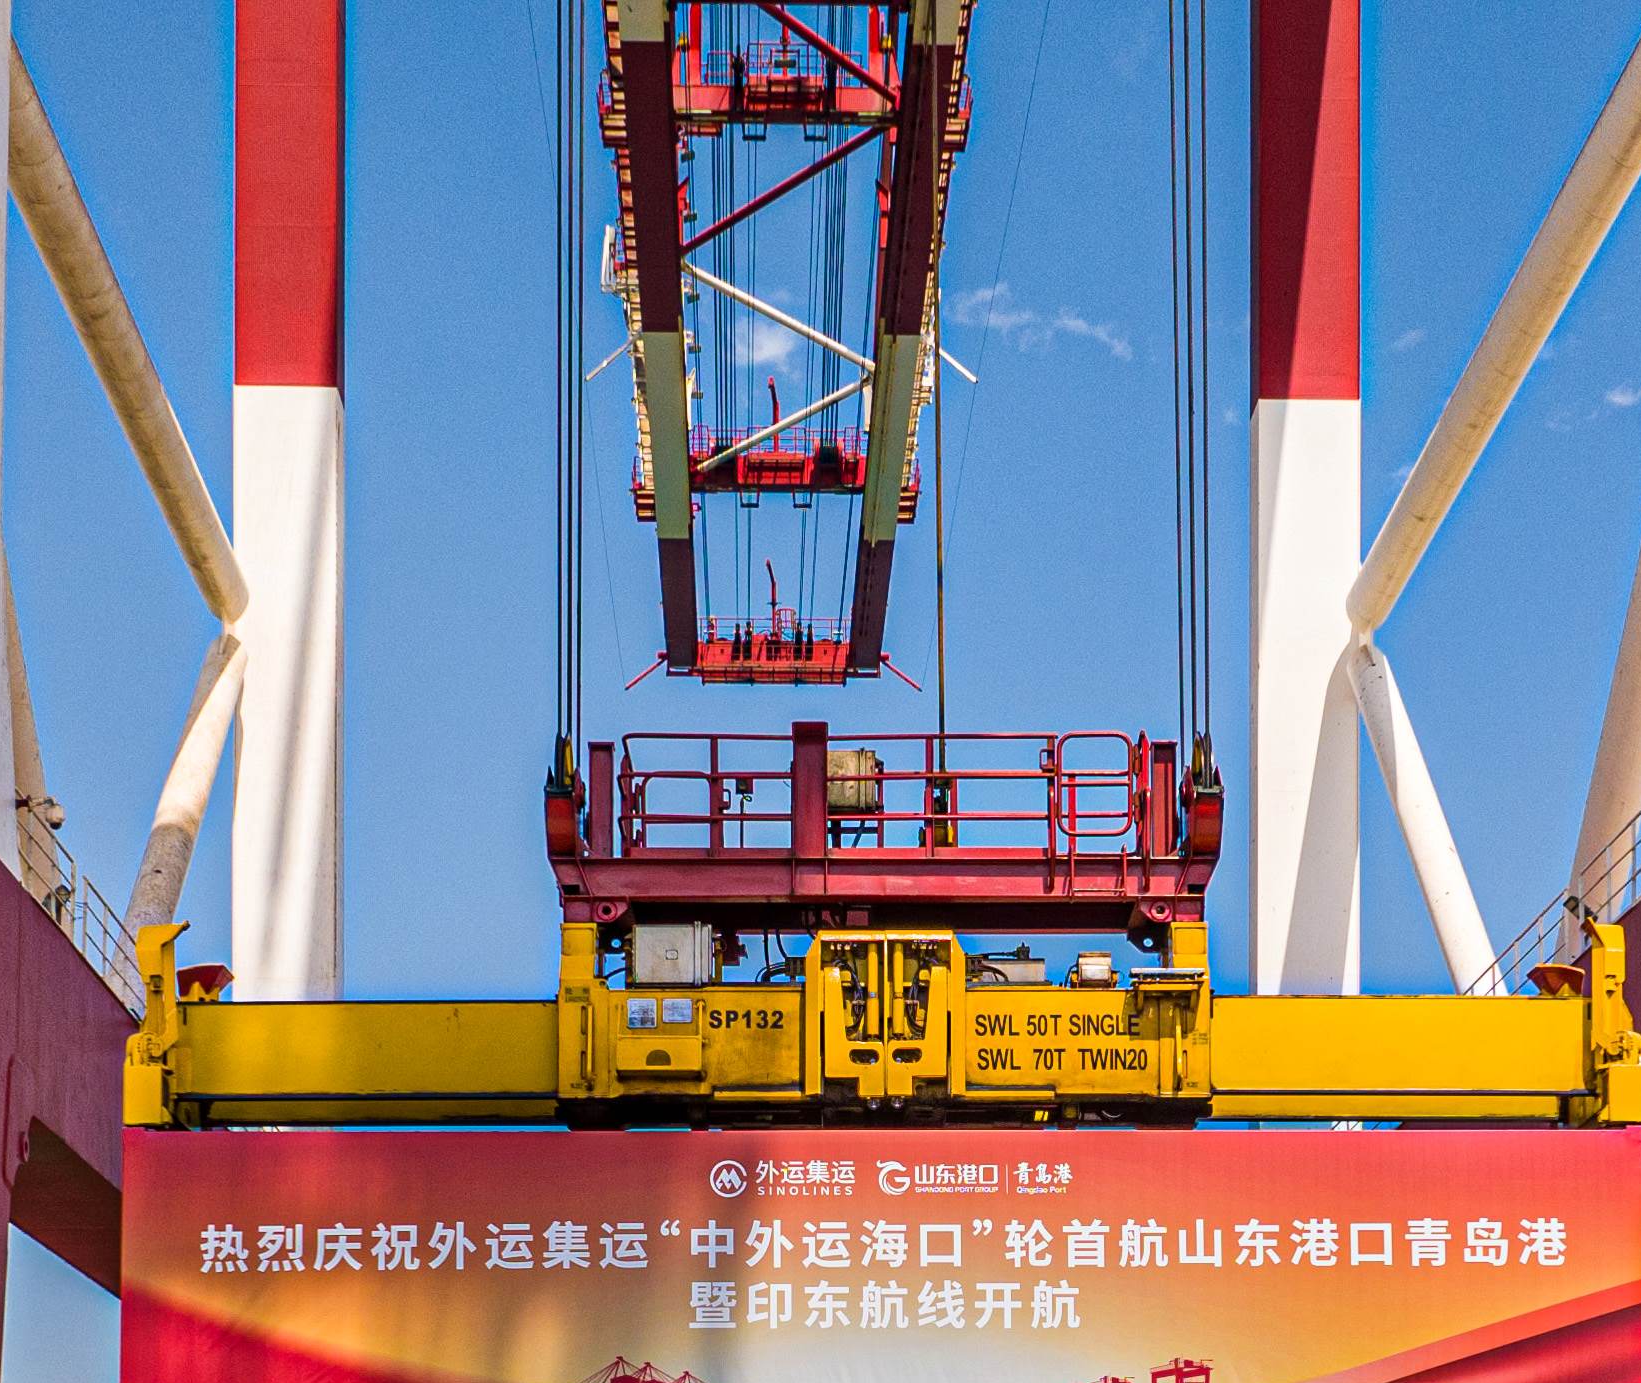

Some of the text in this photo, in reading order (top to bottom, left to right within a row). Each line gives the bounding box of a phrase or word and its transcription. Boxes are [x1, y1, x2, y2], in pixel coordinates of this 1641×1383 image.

[709, 1010, 784, 1029] SP132
[975, 1014, 1141, 1036] SWL 50T SINGLE
[977, 1049, 1148, 1070] SWL 70T TWIN20
[755, 1160, 856, 1184] 外运集运
[914, 1163, 999, 1185] 山东港口
[1012, 1162, 1074, 1185] 青岛港
[757, 1185, 853, 1196] SINOLINES
[1016, 1186, 1048, 1195] Qingdao
[688, 1280, 1081, 1330] 暨印东航线开航
